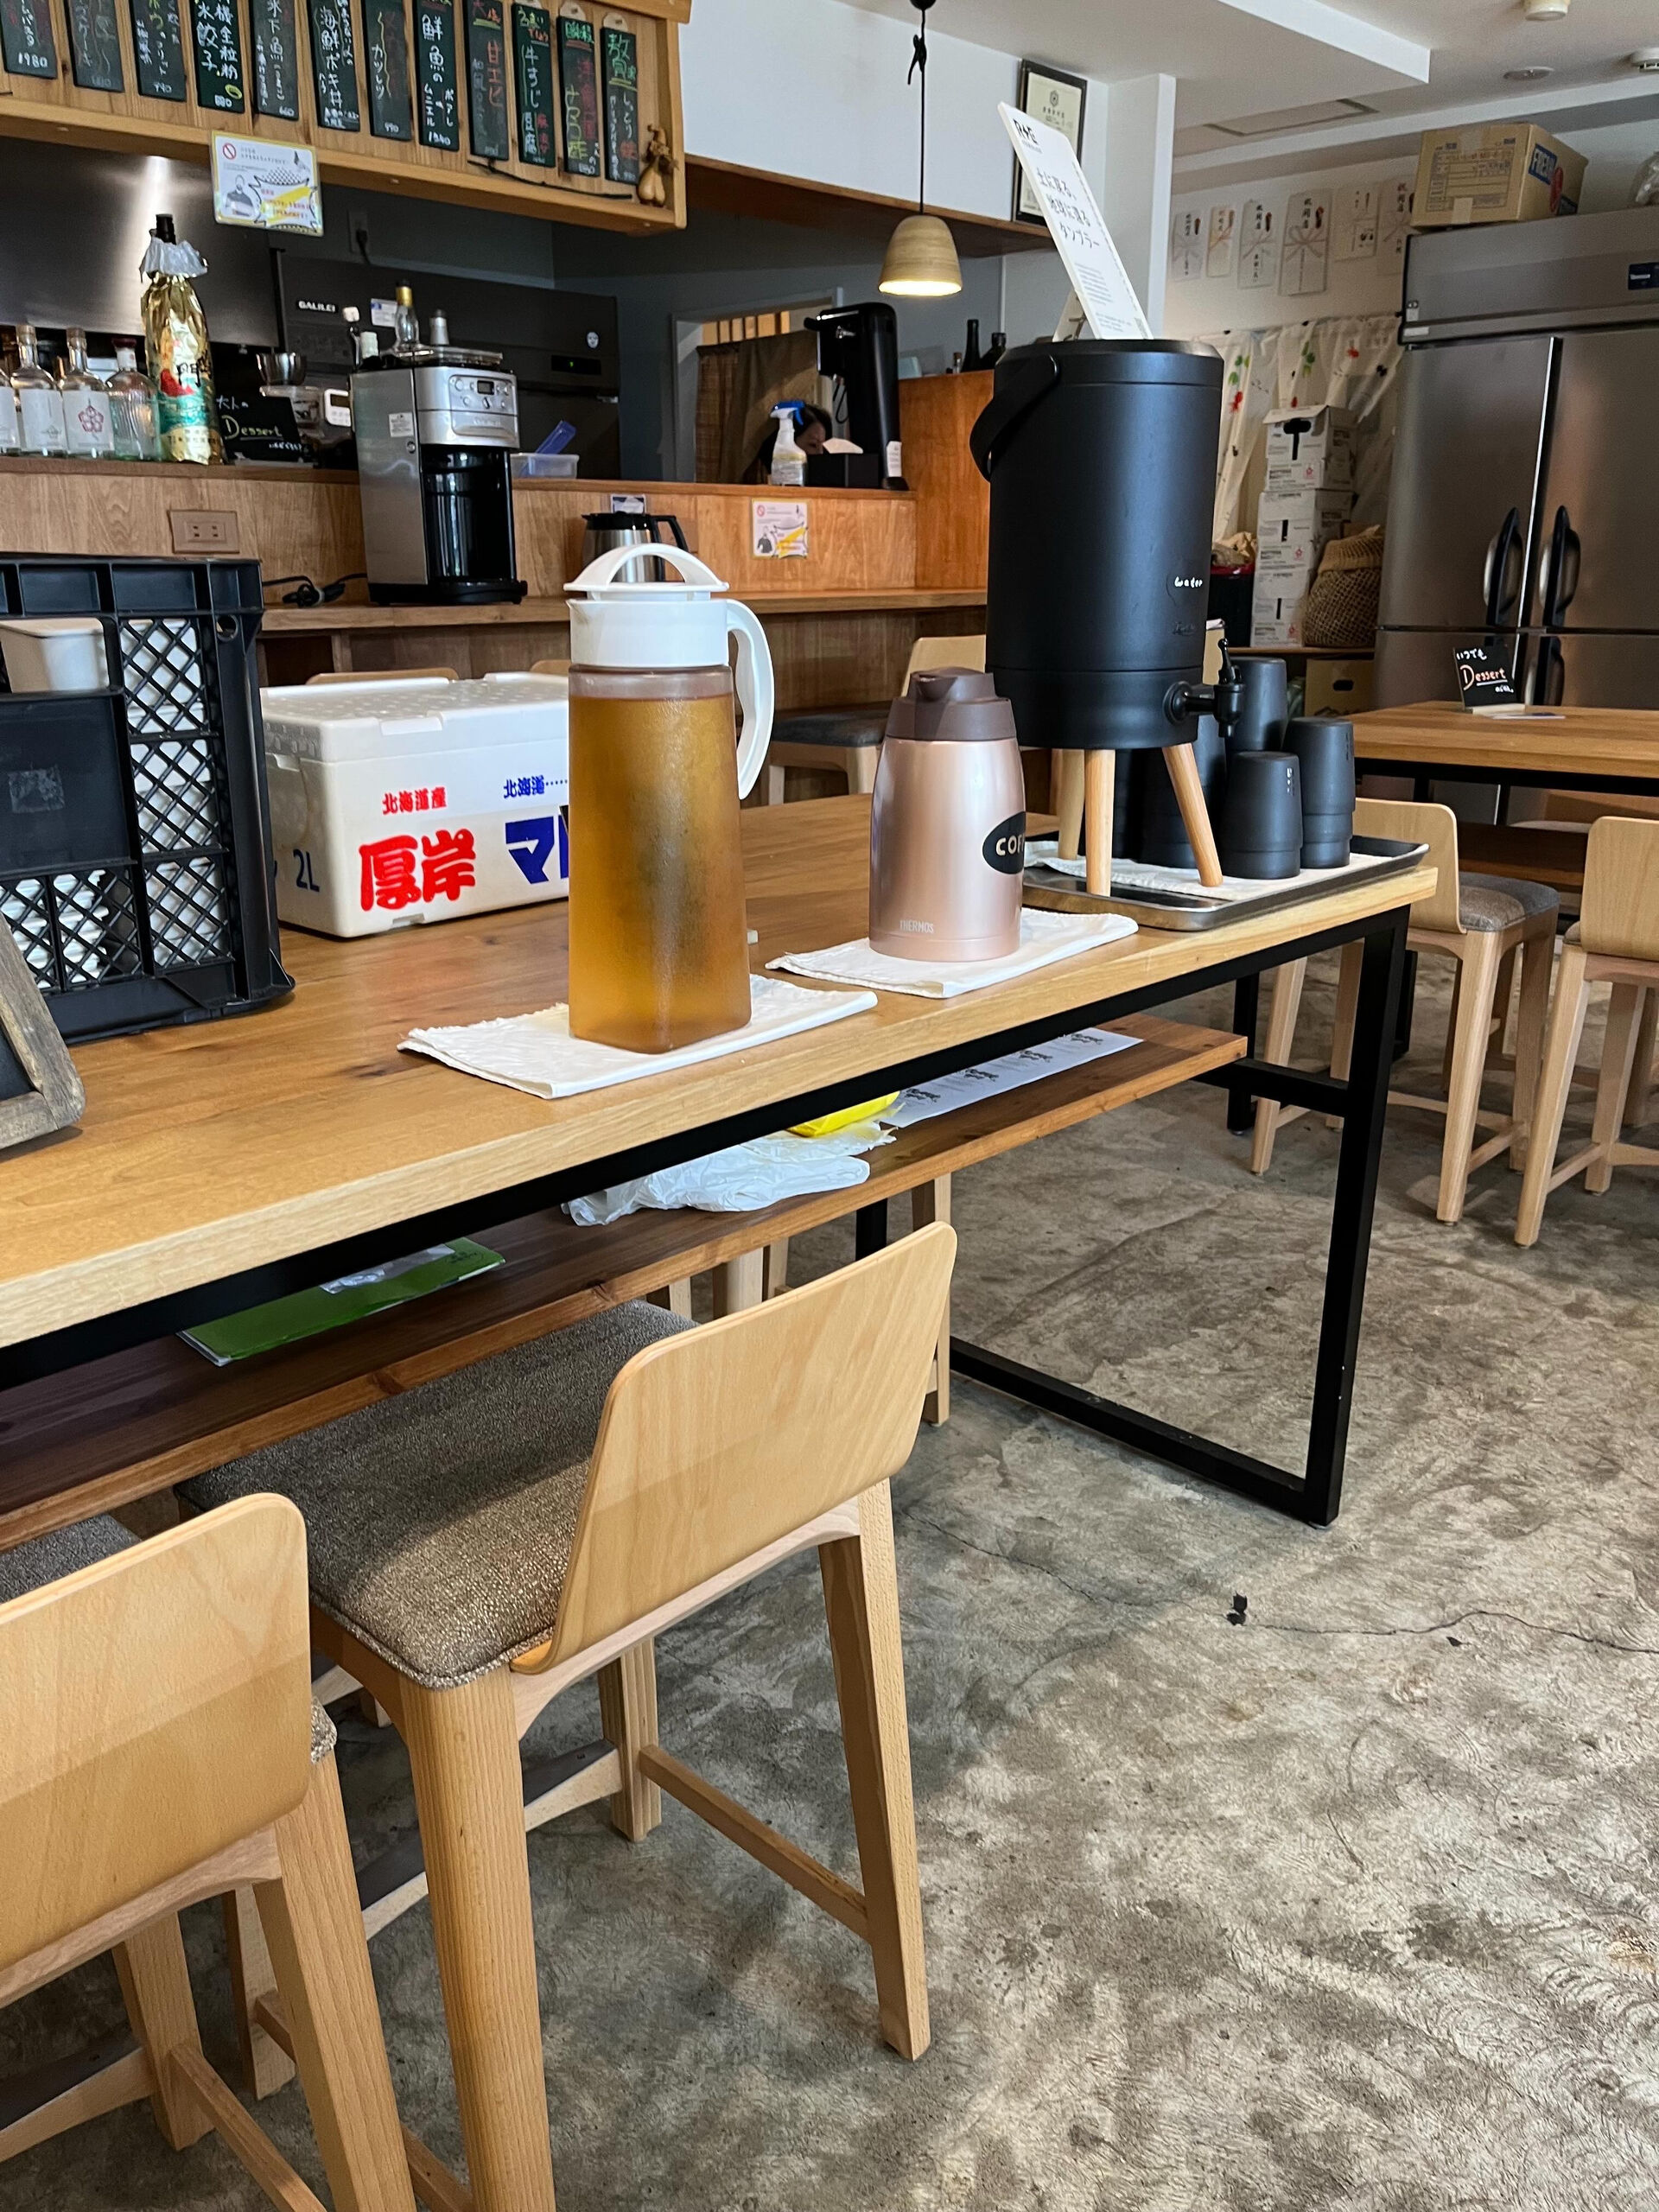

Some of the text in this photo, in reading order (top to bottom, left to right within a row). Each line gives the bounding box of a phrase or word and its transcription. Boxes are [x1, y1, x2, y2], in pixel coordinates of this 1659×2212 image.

[213, 0, 238, 79] 機全粒粉
[221, 415, 283, 440] Dessert
[1459, 664, 1506, 691] Dessert
[382, 785, 448, 815] 北海道産
[504, 774, 545, 799] 北海道
[995, 834, 1025, 856] COF
[292, 848, 320, 893] 2L
[359, 828, 476, 912] 厚岸
[899, 918, 934, 934] THERMOS
